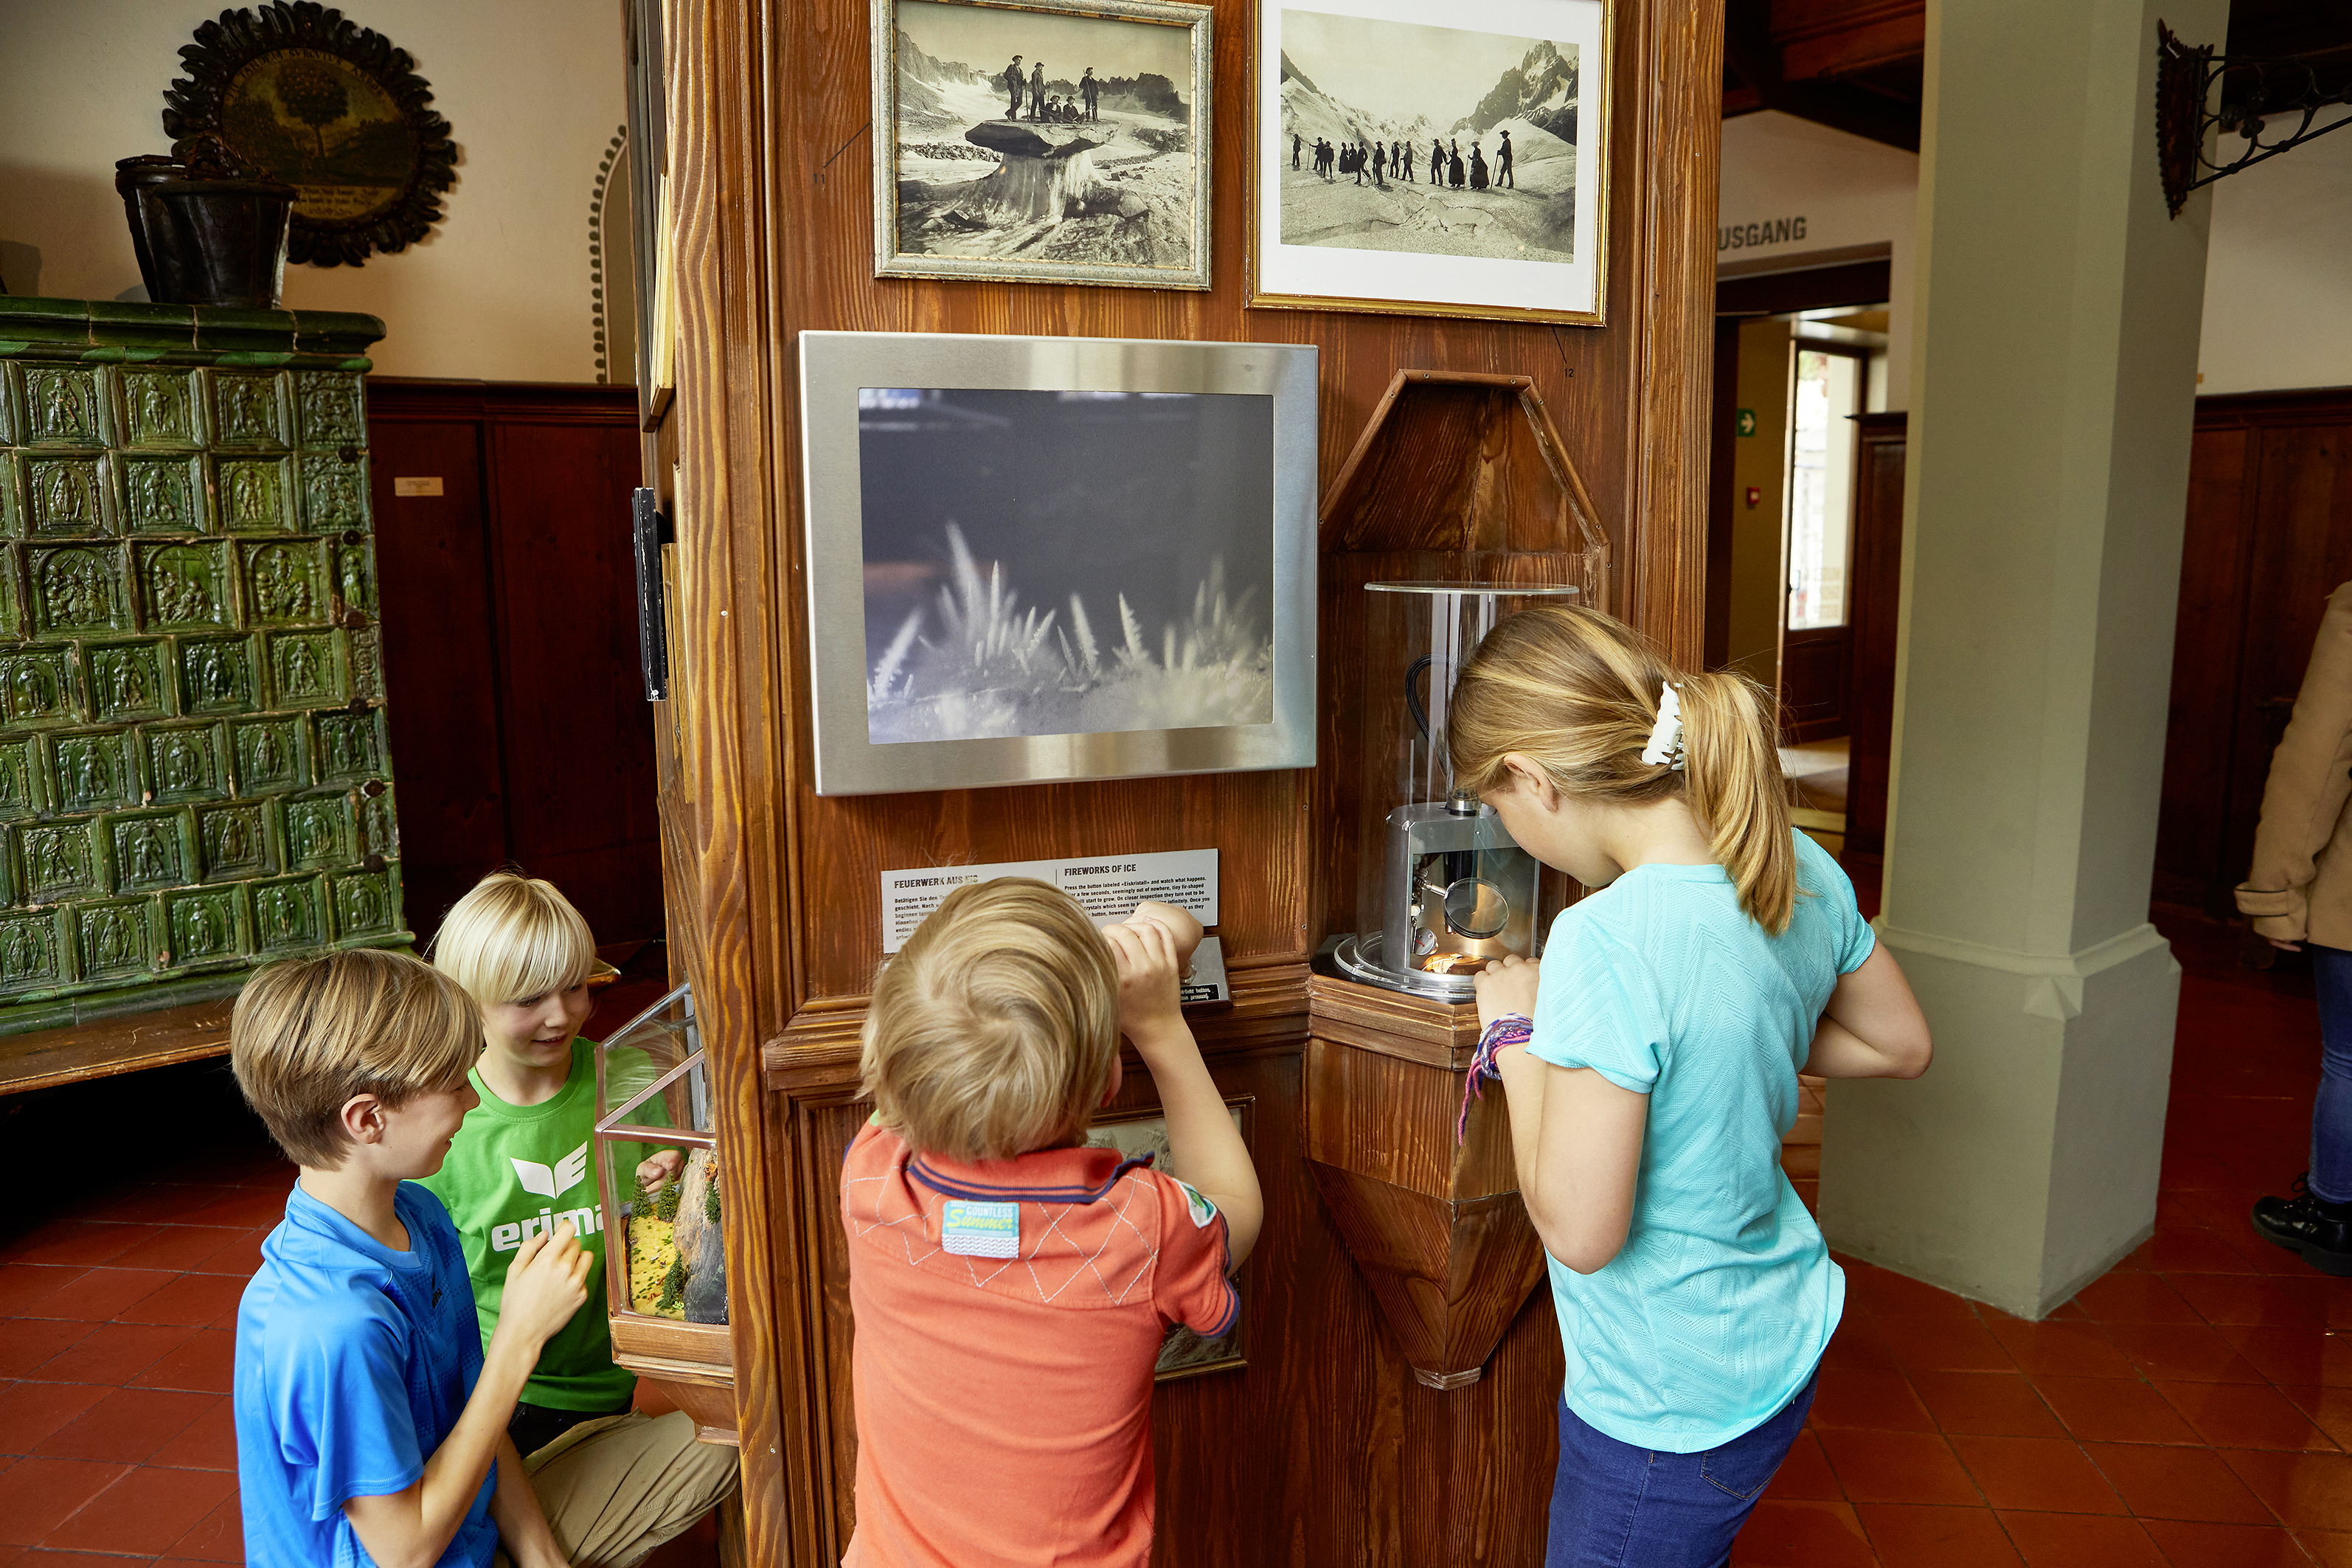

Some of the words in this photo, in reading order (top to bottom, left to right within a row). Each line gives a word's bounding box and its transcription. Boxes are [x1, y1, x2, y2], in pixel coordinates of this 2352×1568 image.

[814, 173, 825, 184] 11
[1718, 216, 1807, 251] USGANG
[1564, 358, 1574, 366] 12
[1064, 865, 1110, 876] FIREWORKS
[1111, 864, 1122, 873] OF
[1124, 864, 1137, 872] ICE
[894, 878, 945, 889] FEUERWERK
[946, 875, 963, 884] AUS
[966, 1205, 1013, 1218] COUNTLESS
[946, 1208, 1013, 1230] Summer
